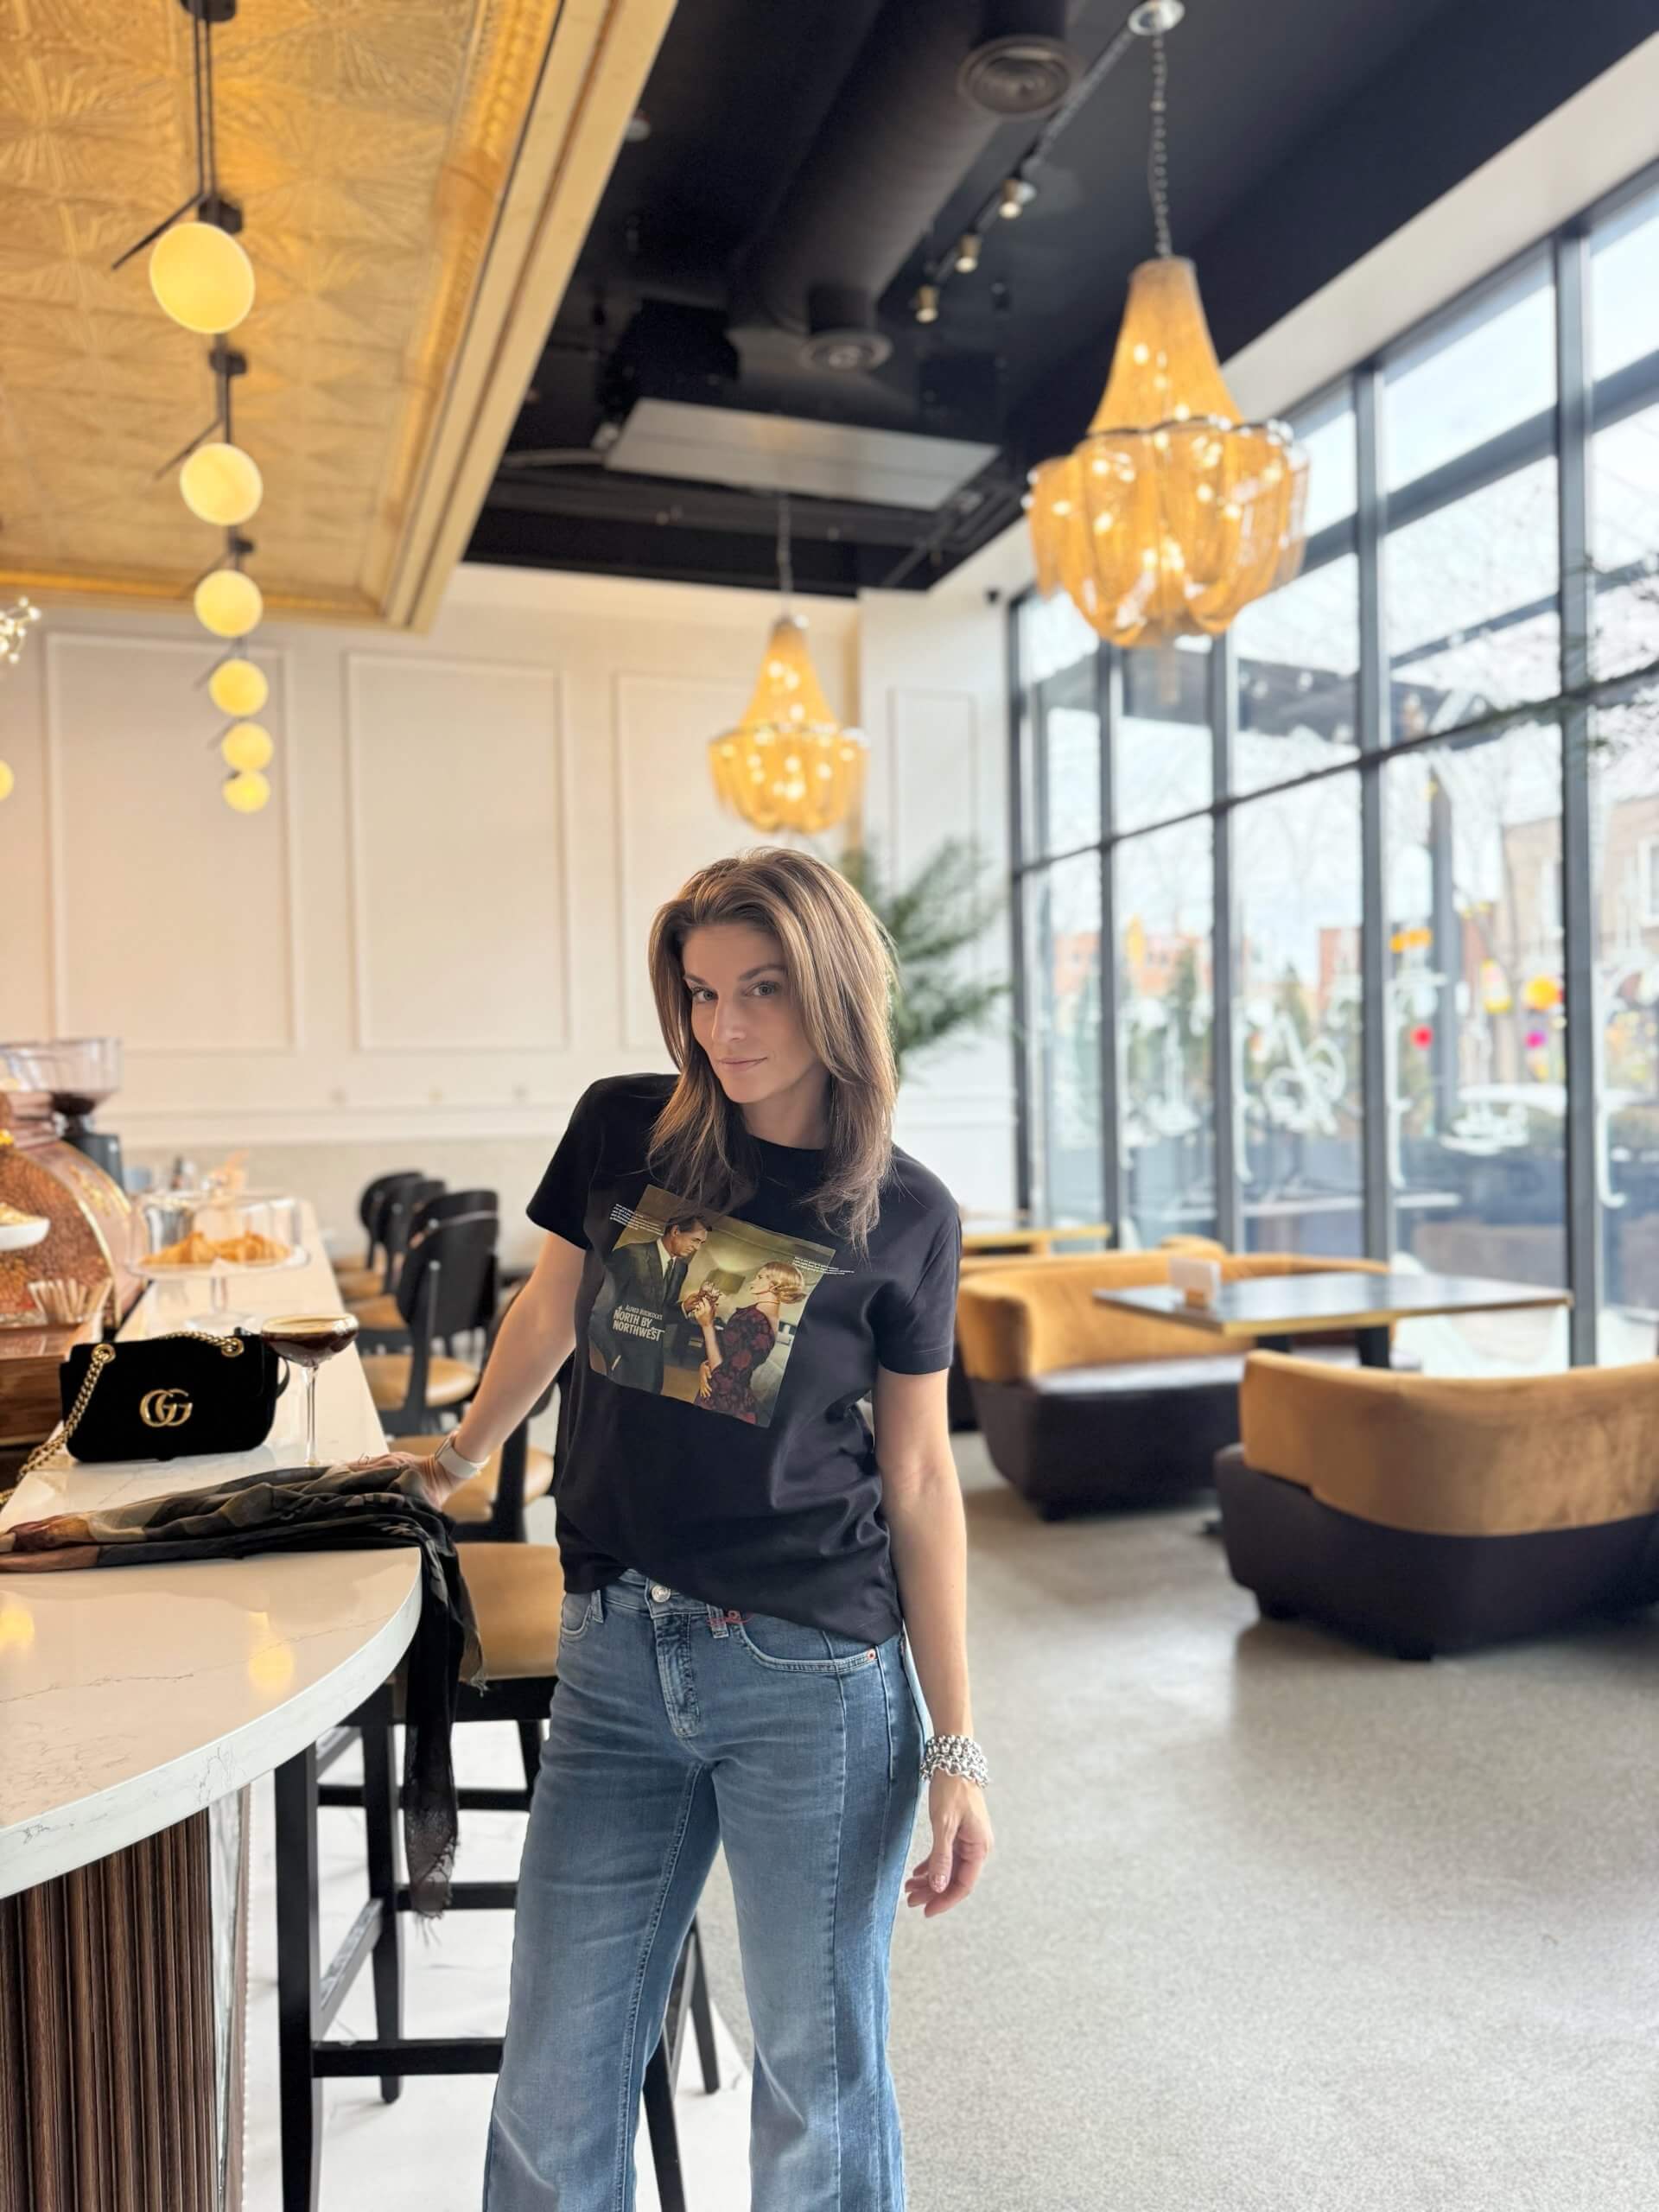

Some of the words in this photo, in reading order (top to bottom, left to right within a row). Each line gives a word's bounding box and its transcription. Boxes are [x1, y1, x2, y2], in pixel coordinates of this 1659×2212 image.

[613, 1307, 640, 1325] NORTH
[640, 1316, 653, 1328] BY
[613, 1319, 665, 1341] NORTHWEST
